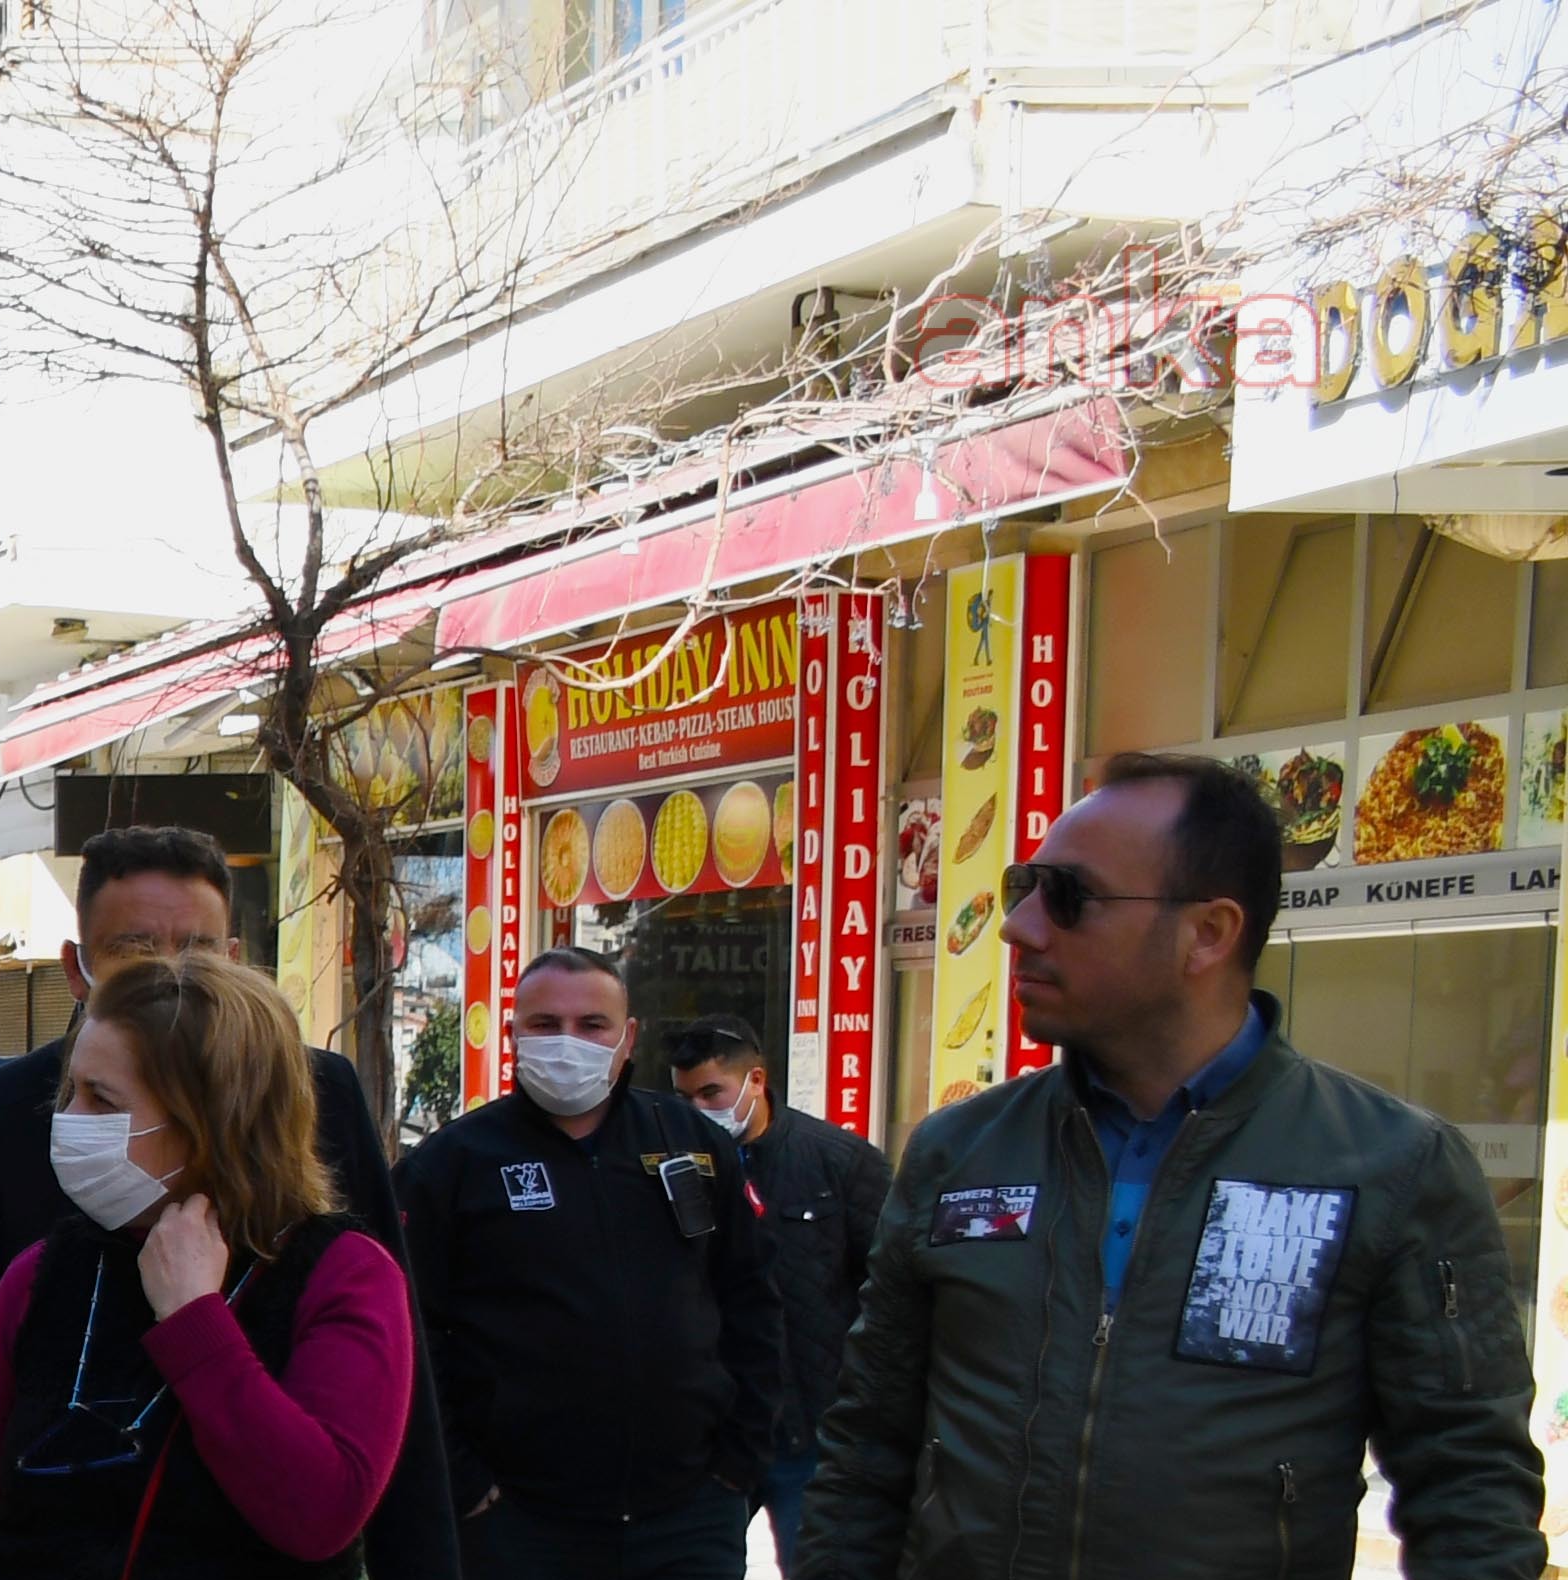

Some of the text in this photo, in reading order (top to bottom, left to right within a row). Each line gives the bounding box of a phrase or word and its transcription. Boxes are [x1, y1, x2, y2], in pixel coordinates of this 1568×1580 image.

[566, 611, 796, 730] HOLIDAY INN
[757, 695, 797, 724] HOUS
[638, 740, 721, 771] Best Turkish Cuisine
[801, 602, 823, 977] HOLIDAY
[841, 617, 874, 991] HOLIDAY
[501, 796, 518, 979] HOLIDAY
[1366, 875, 1476, 903] KÜNEFE
[892, 924, 936, 943] FRES
[833, 1013, 870, 1032] INN
[1484, 1141, 1508, 1160] INN
[940, 1188, 993, 1204] POWER
[1223, 1187, 1341, 1240] MAKE
[1218, 1231, 1322, 1287] LOVE
[1231, 1279, 1296, 1315] NOT
[1219, 1308, 1292, 1345] WAR
